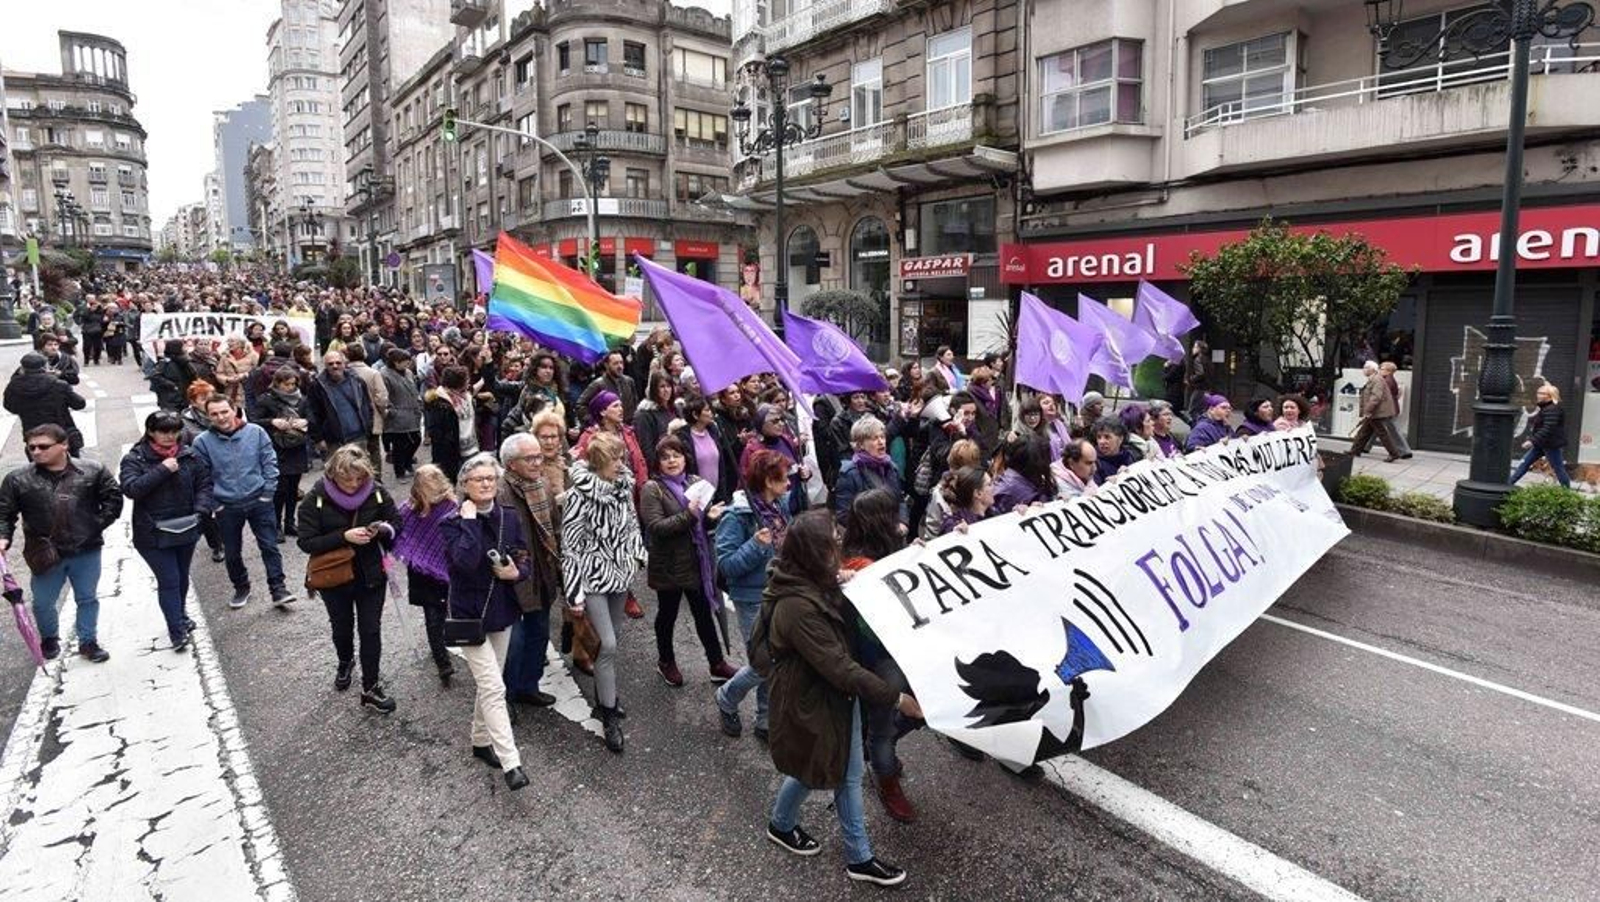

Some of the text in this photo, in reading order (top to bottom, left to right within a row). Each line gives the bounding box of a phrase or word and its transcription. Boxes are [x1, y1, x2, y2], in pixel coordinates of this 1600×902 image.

[903, 257, 964, 271] GASPAR
[1046, 243, 1155, 278] arenal
[881, 538, 1030, 630] PARA
[1018, 465, 1199, 560] TRANSFORMAR
[1135, 508, 1265, 632] FOLGA!
